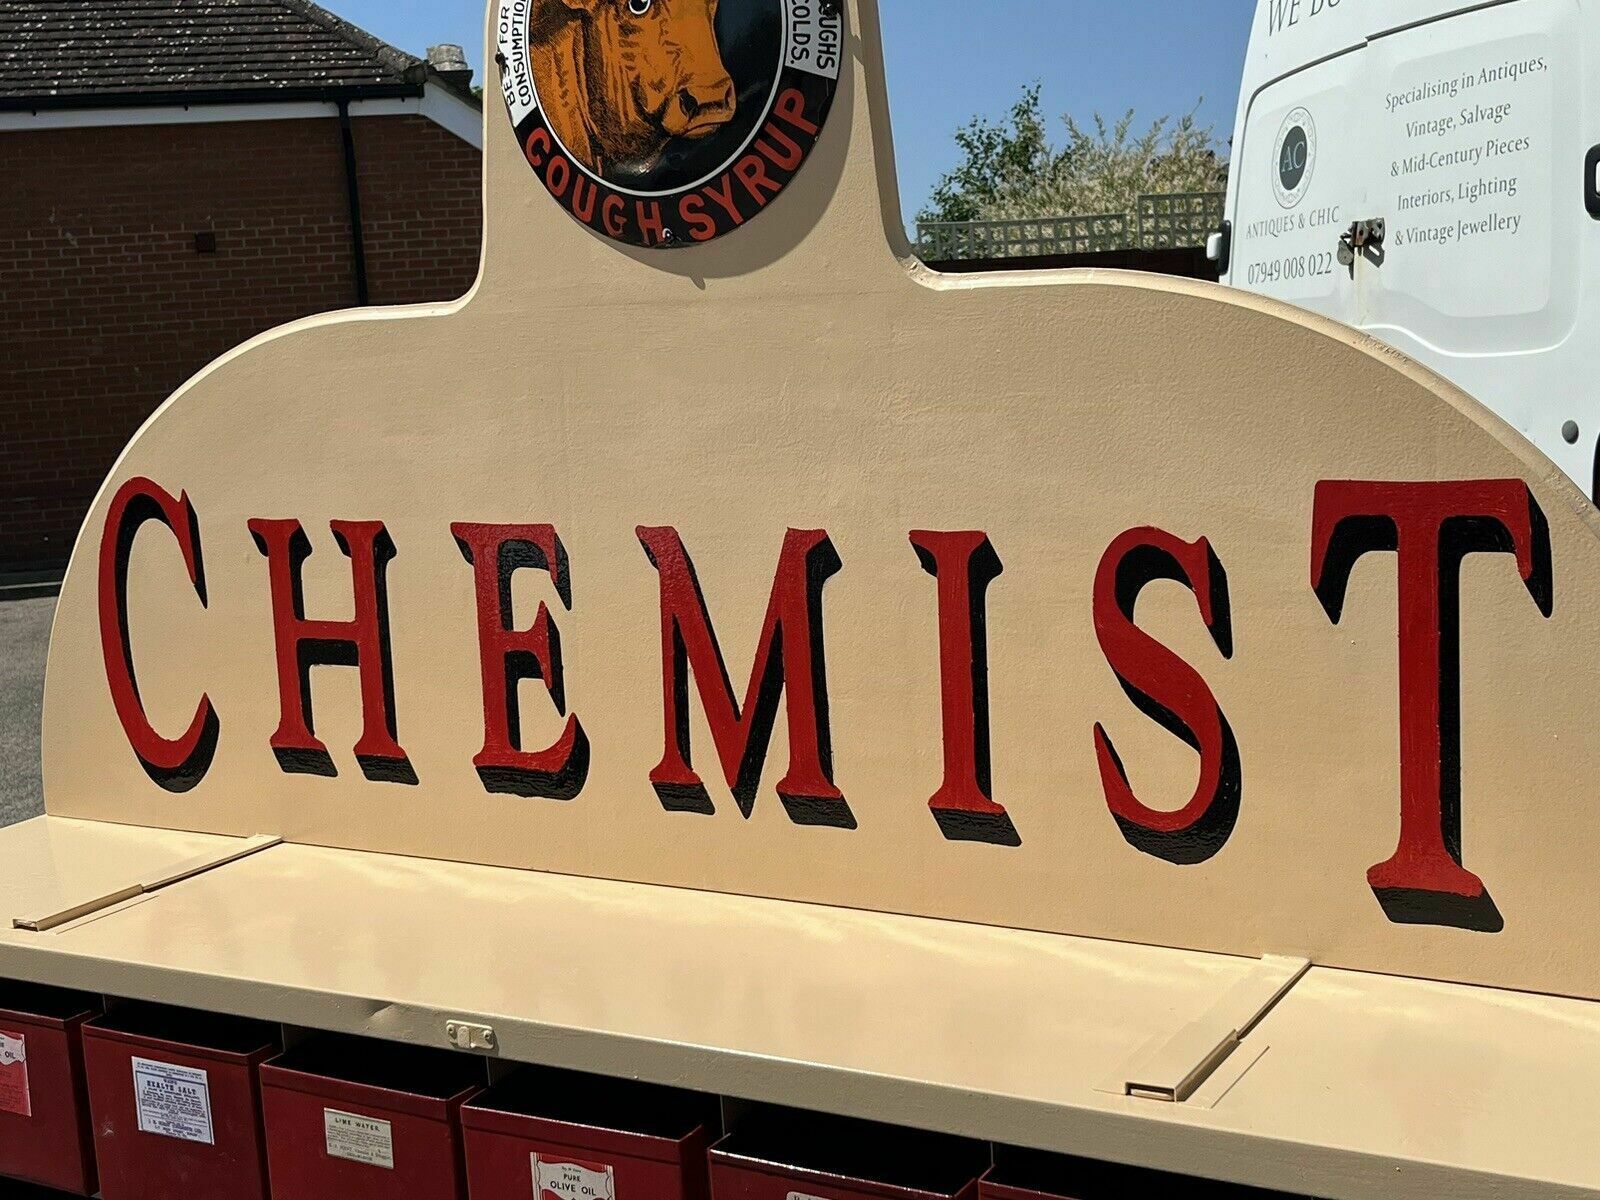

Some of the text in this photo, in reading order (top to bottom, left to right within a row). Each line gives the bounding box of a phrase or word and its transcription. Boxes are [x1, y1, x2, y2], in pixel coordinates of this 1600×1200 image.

[816, 0, 838, 70] UGHS
[499, 6, 516, 106] BES FOR
[512, 0, 532, 107] CONSUMPTIO
[1385, 56, 1548, 113] Specialising in Antiques,
[1406, 102, 1512, 138] Vintage, Salvage
[526, 88, 818, 245] COUGH SYRUP
[1281, 141, 1306, 173] AC
[1390, 136, 1530, 177] & Mid-Century Pieces
[1397, 176, 1518, 211] Interiors, Lighting
[1246, 206, 1340, 239] ANTIQUES & CHIC
[1395, 213, 1522, 246] & Vintage Jewellery
[1248, 252, 1332, 284] 07949 008 022
[98, 476, 1554, 933] CHEMIST
[550, 1180, 597, 1197] OLIVE OIL
[563, 1173, 581, 1183] PURE
